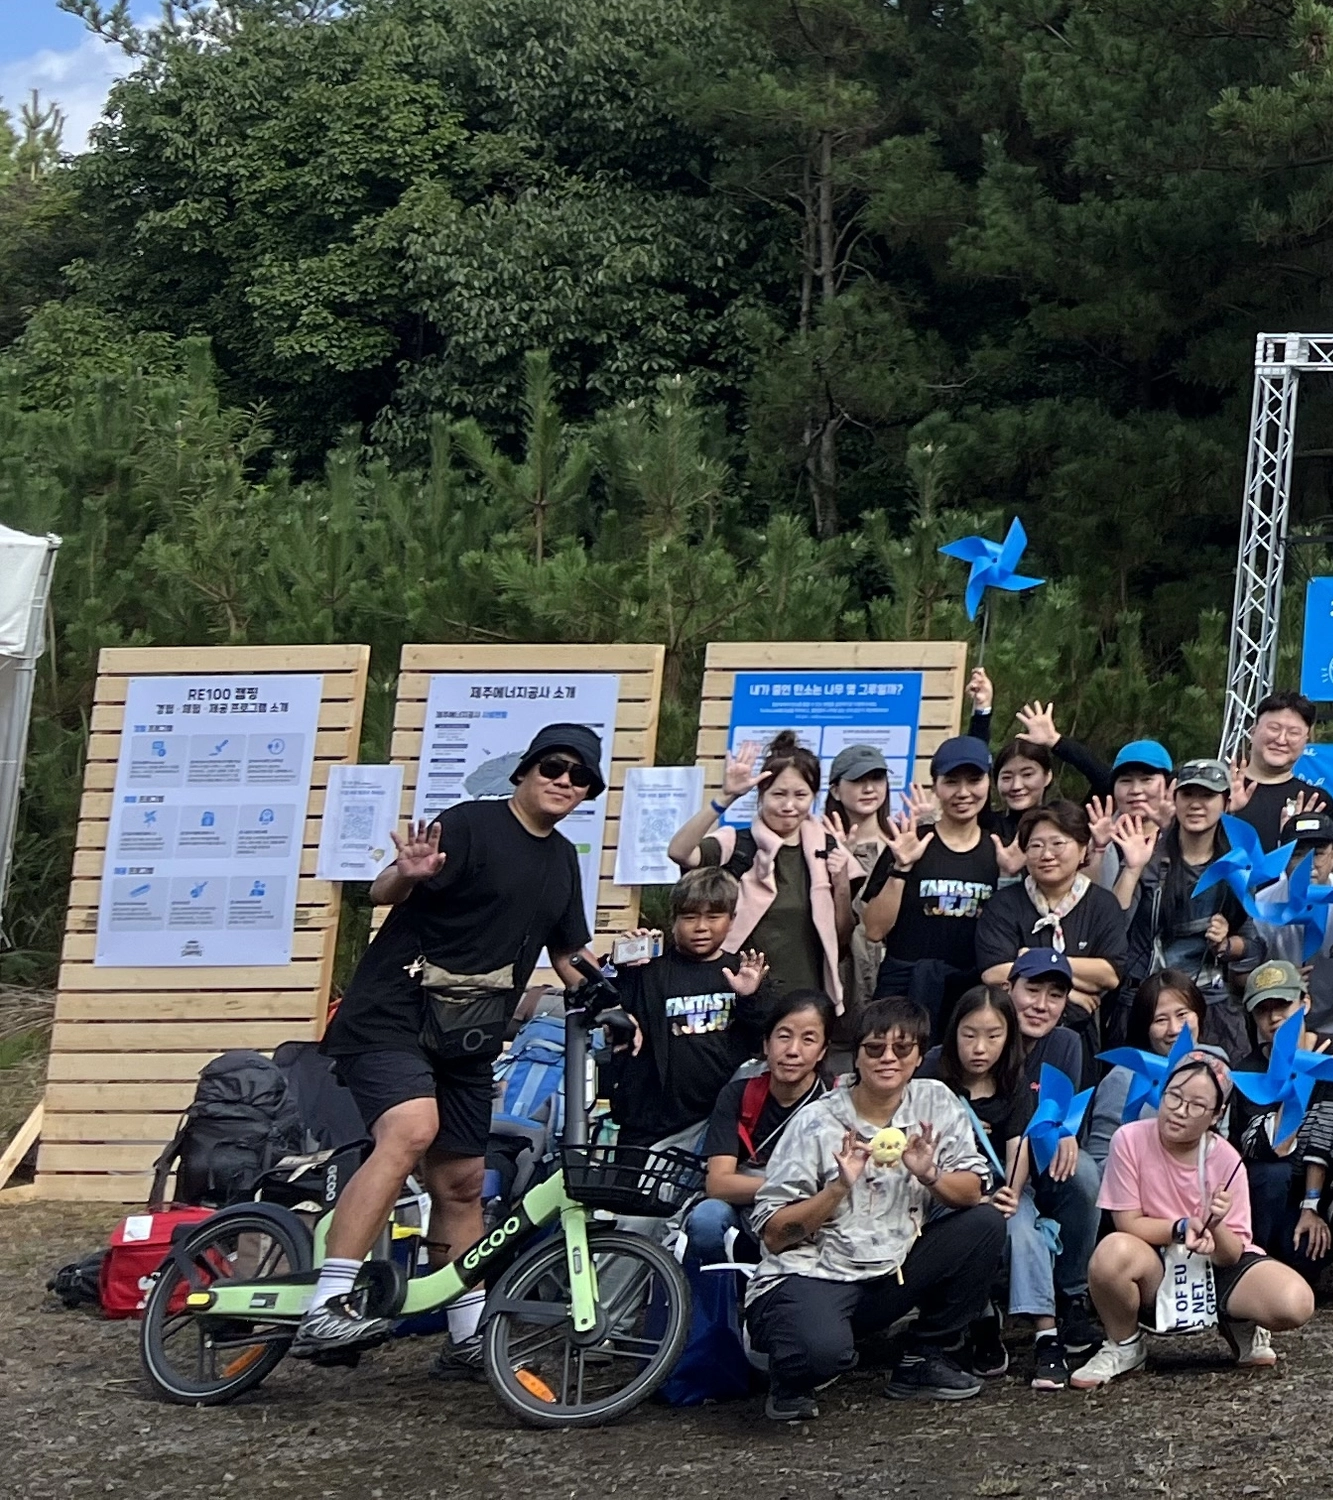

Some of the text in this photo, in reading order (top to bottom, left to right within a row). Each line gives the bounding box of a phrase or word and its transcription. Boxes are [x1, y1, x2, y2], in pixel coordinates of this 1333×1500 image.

[187, 687, 258, 700] RE100 캠핑
[470, 686, 576, 699] 제주에너지공사 소개
[750, 684, 770, 696] 내가
[325, 1164, 339, 1202] GCOO
[463, 1216, 520, 1270] GCOO
[1173, 1264, 1188, 1286] EU
[1174, 1291, 1189, 1312] OF
[1191, 1278, 1205, 1314] NET.
